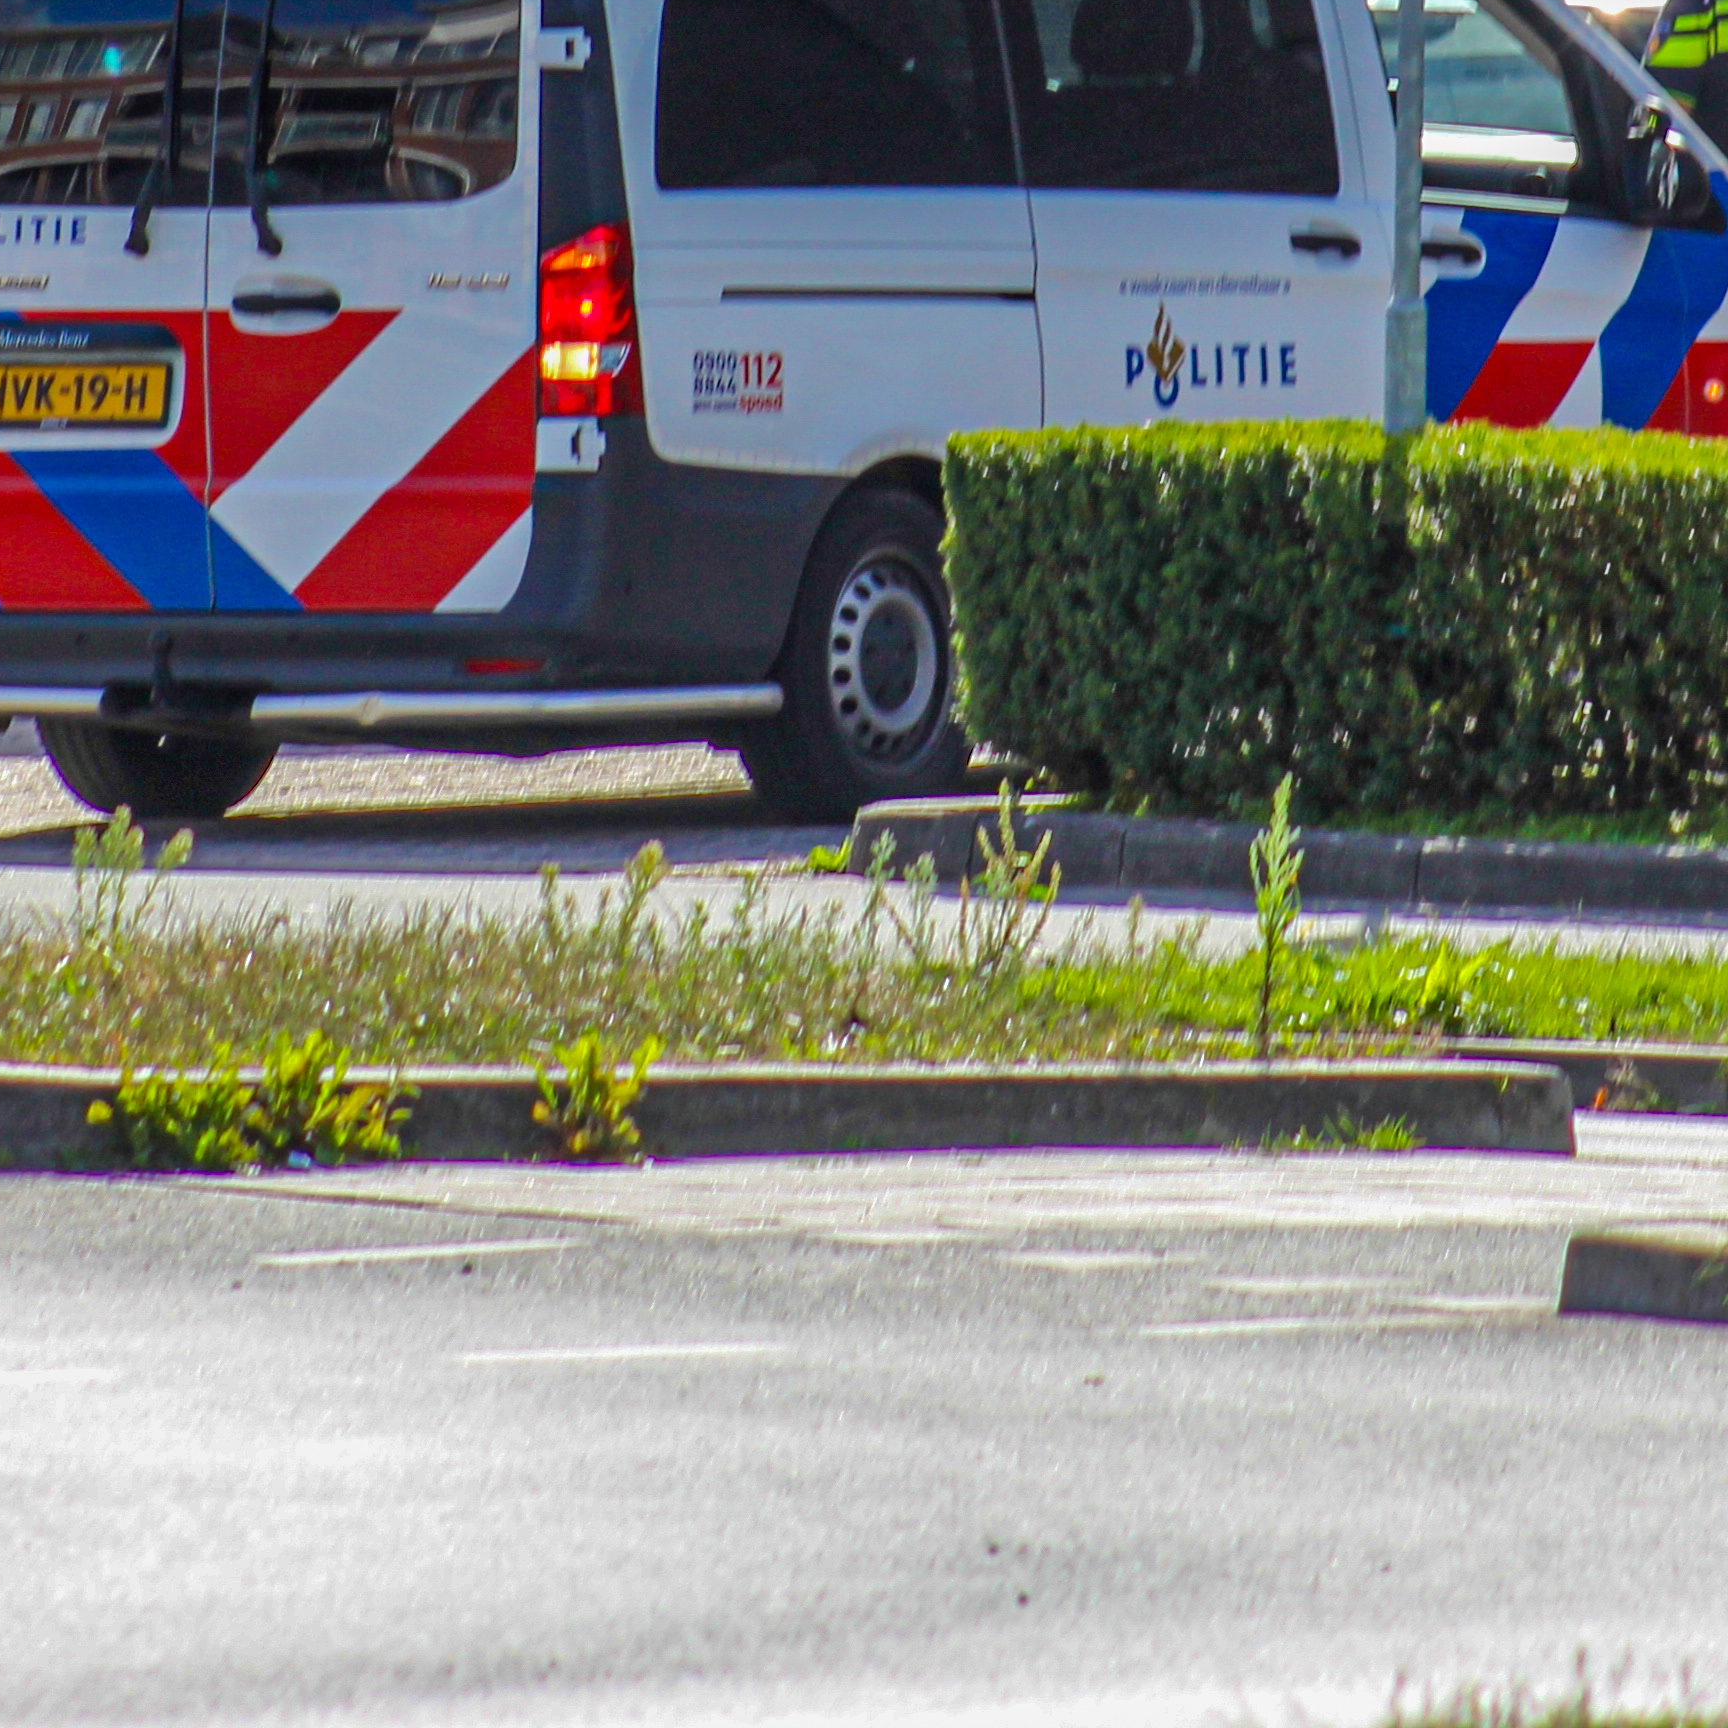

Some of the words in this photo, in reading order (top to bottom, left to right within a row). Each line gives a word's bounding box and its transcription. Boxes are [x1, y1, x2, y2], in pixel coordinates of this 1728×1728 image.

[693, 351, 736, 373] 0900
[740, 352, 783, 389] 112
[1126, 338, 1297, 409] POLITIE
[693, 375, 736, 395] 8844
